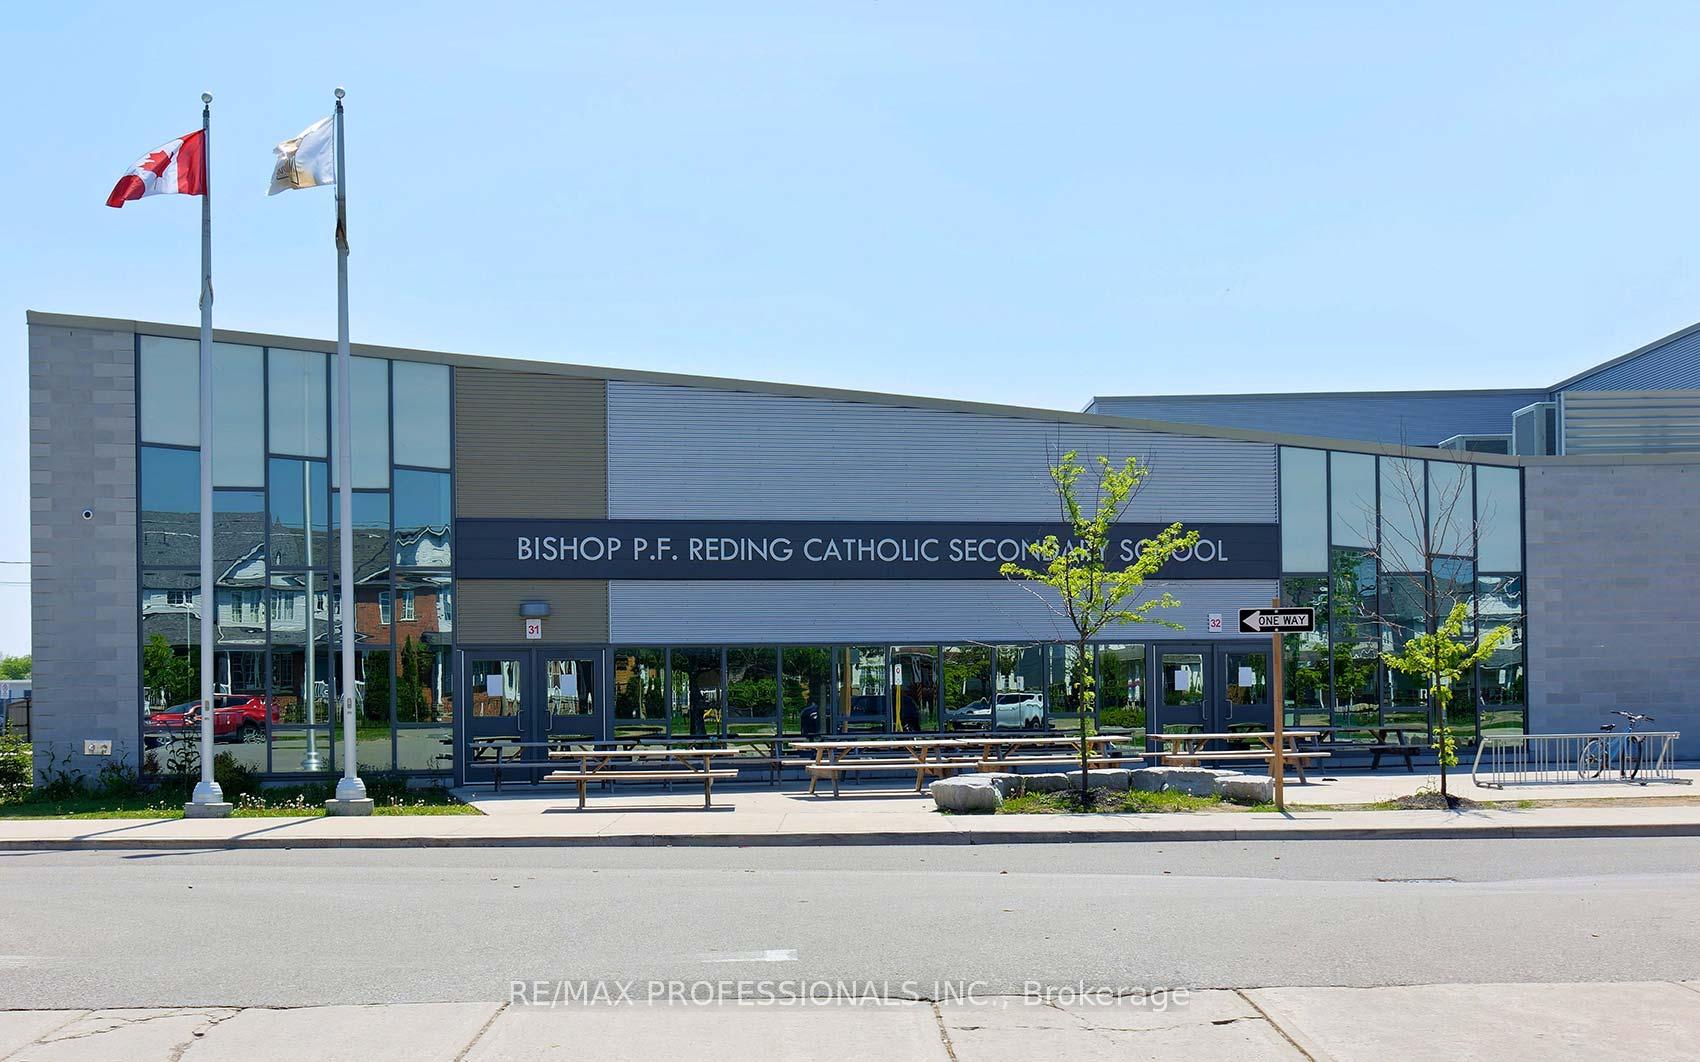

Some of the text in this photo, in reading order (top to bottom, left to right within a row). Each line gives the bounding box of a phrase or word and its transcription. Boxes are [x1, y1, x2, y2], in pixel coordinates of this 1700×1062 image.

[517, 536, 622, 561] BISHOP
[633, 537, 679, 561] P.F.
[689, 538, 794, 562] REDING
[803, 538, 940, 562] CATHOLIC
[1119, 539, 1229, 562] SCOOL
[1210, 619, 1221, 628] 32
[1258, 616, 1305, 625] ONE WAY
[528, 625, 539, 635] 31
